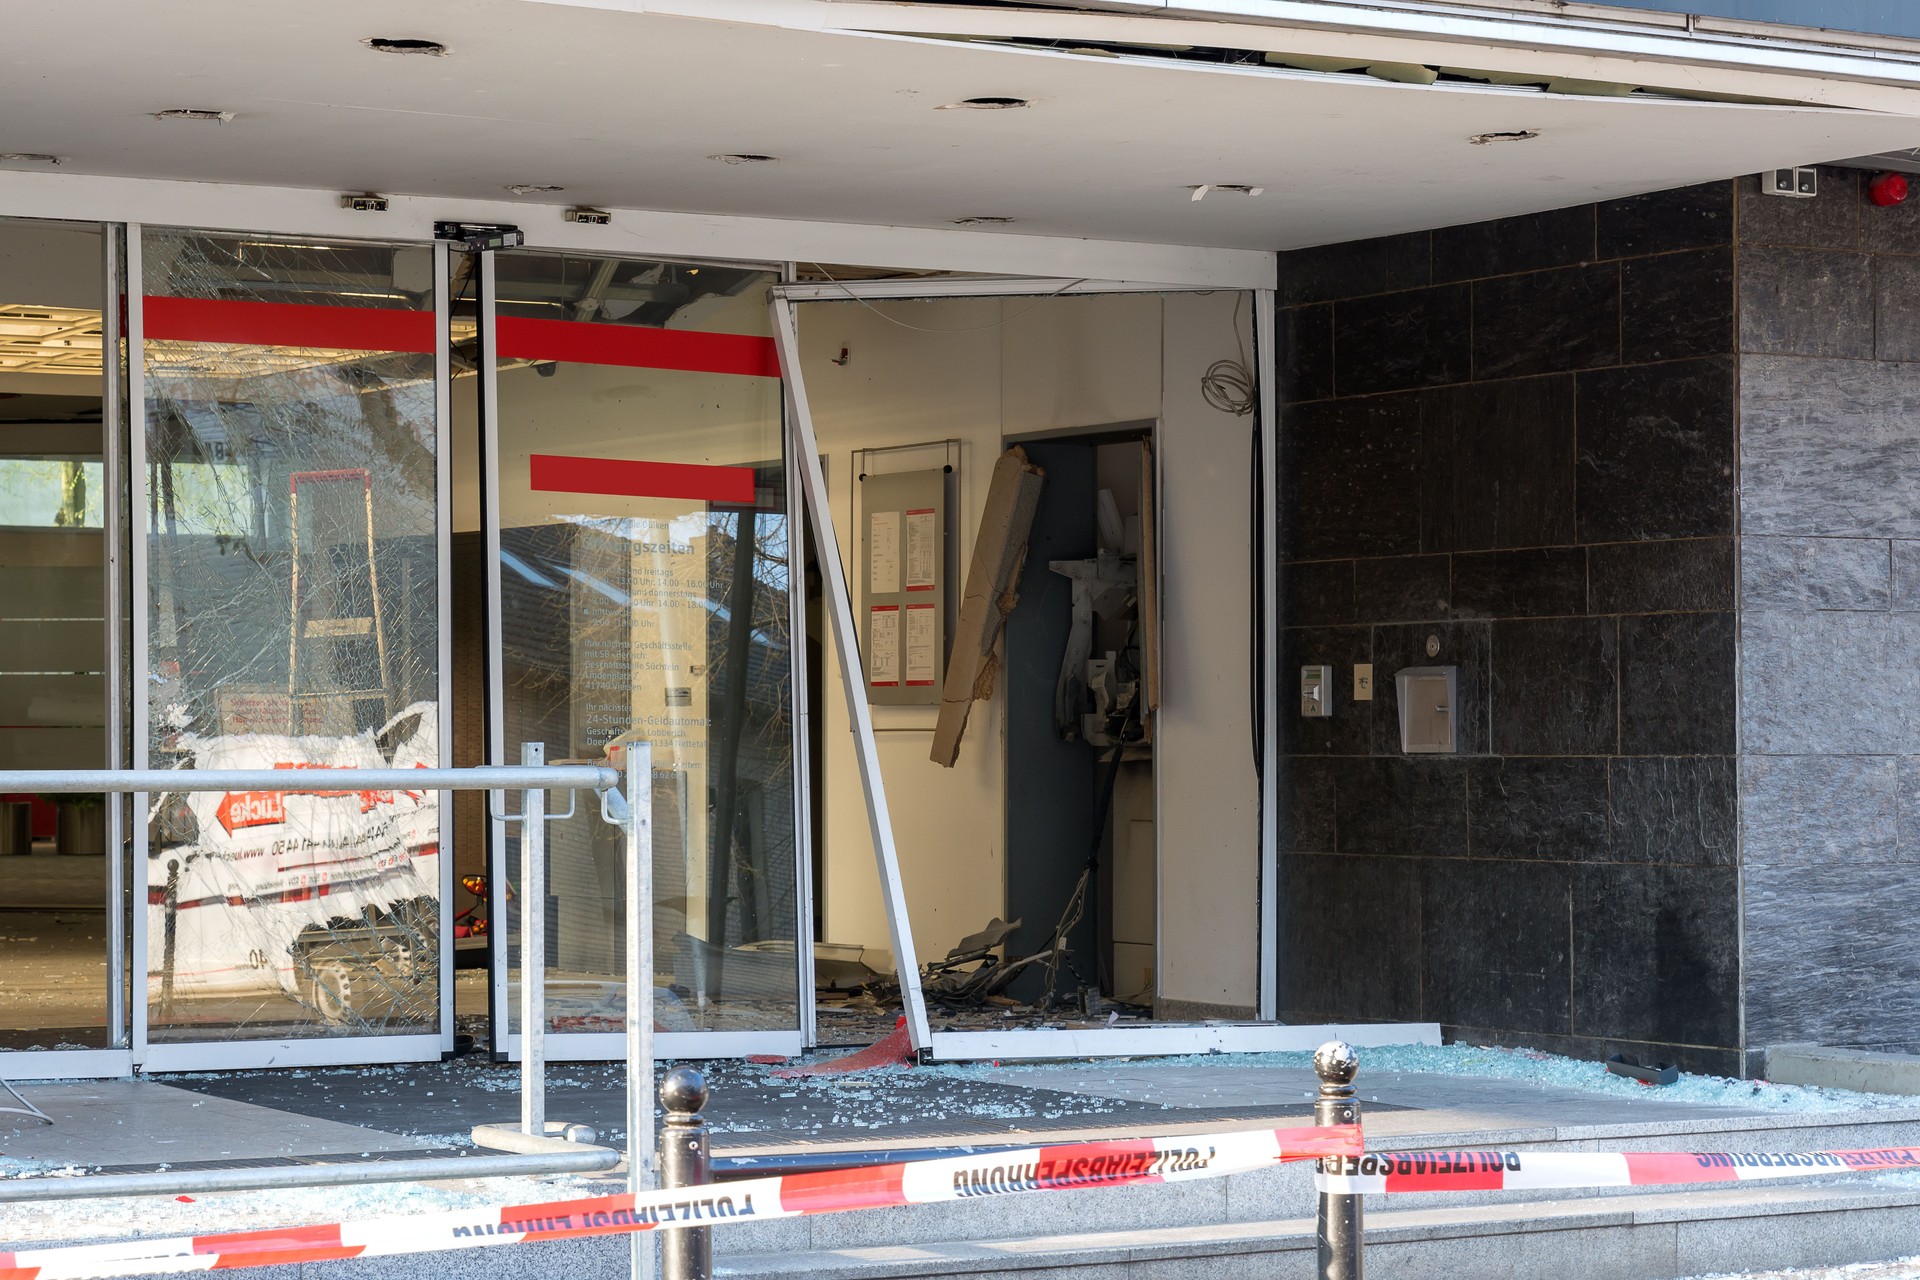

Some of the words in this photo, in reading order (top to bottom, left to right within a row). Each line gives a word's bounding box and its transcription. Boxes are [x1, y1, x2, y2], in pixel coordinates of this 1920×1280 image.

[582, 536, 695, 555] Önungszeiten
[644, 568, 674, 578] freitags
[658, 579, 680, 588] 14.00
[710, 581, 724, 589] Uhr
[632, 588, 647, 597] und
[649, 589, 697, 599] donnerstags
[658, 599, 679, 609] 14.00
[641, 619, 655, 628] Uhr
[634, 641, 693, 651] Geschäftsstelle
[584, 650, 598, 658] mit
[599, 651, 610, 659] SB
[645, 662, 679, 672] Süchteln
[586, 703, 597, 711] Ihr
[647, 728, 686, 738] Lobberich
[953, 1146, 1216, 1198] POLIZEIABSPERRUNG
